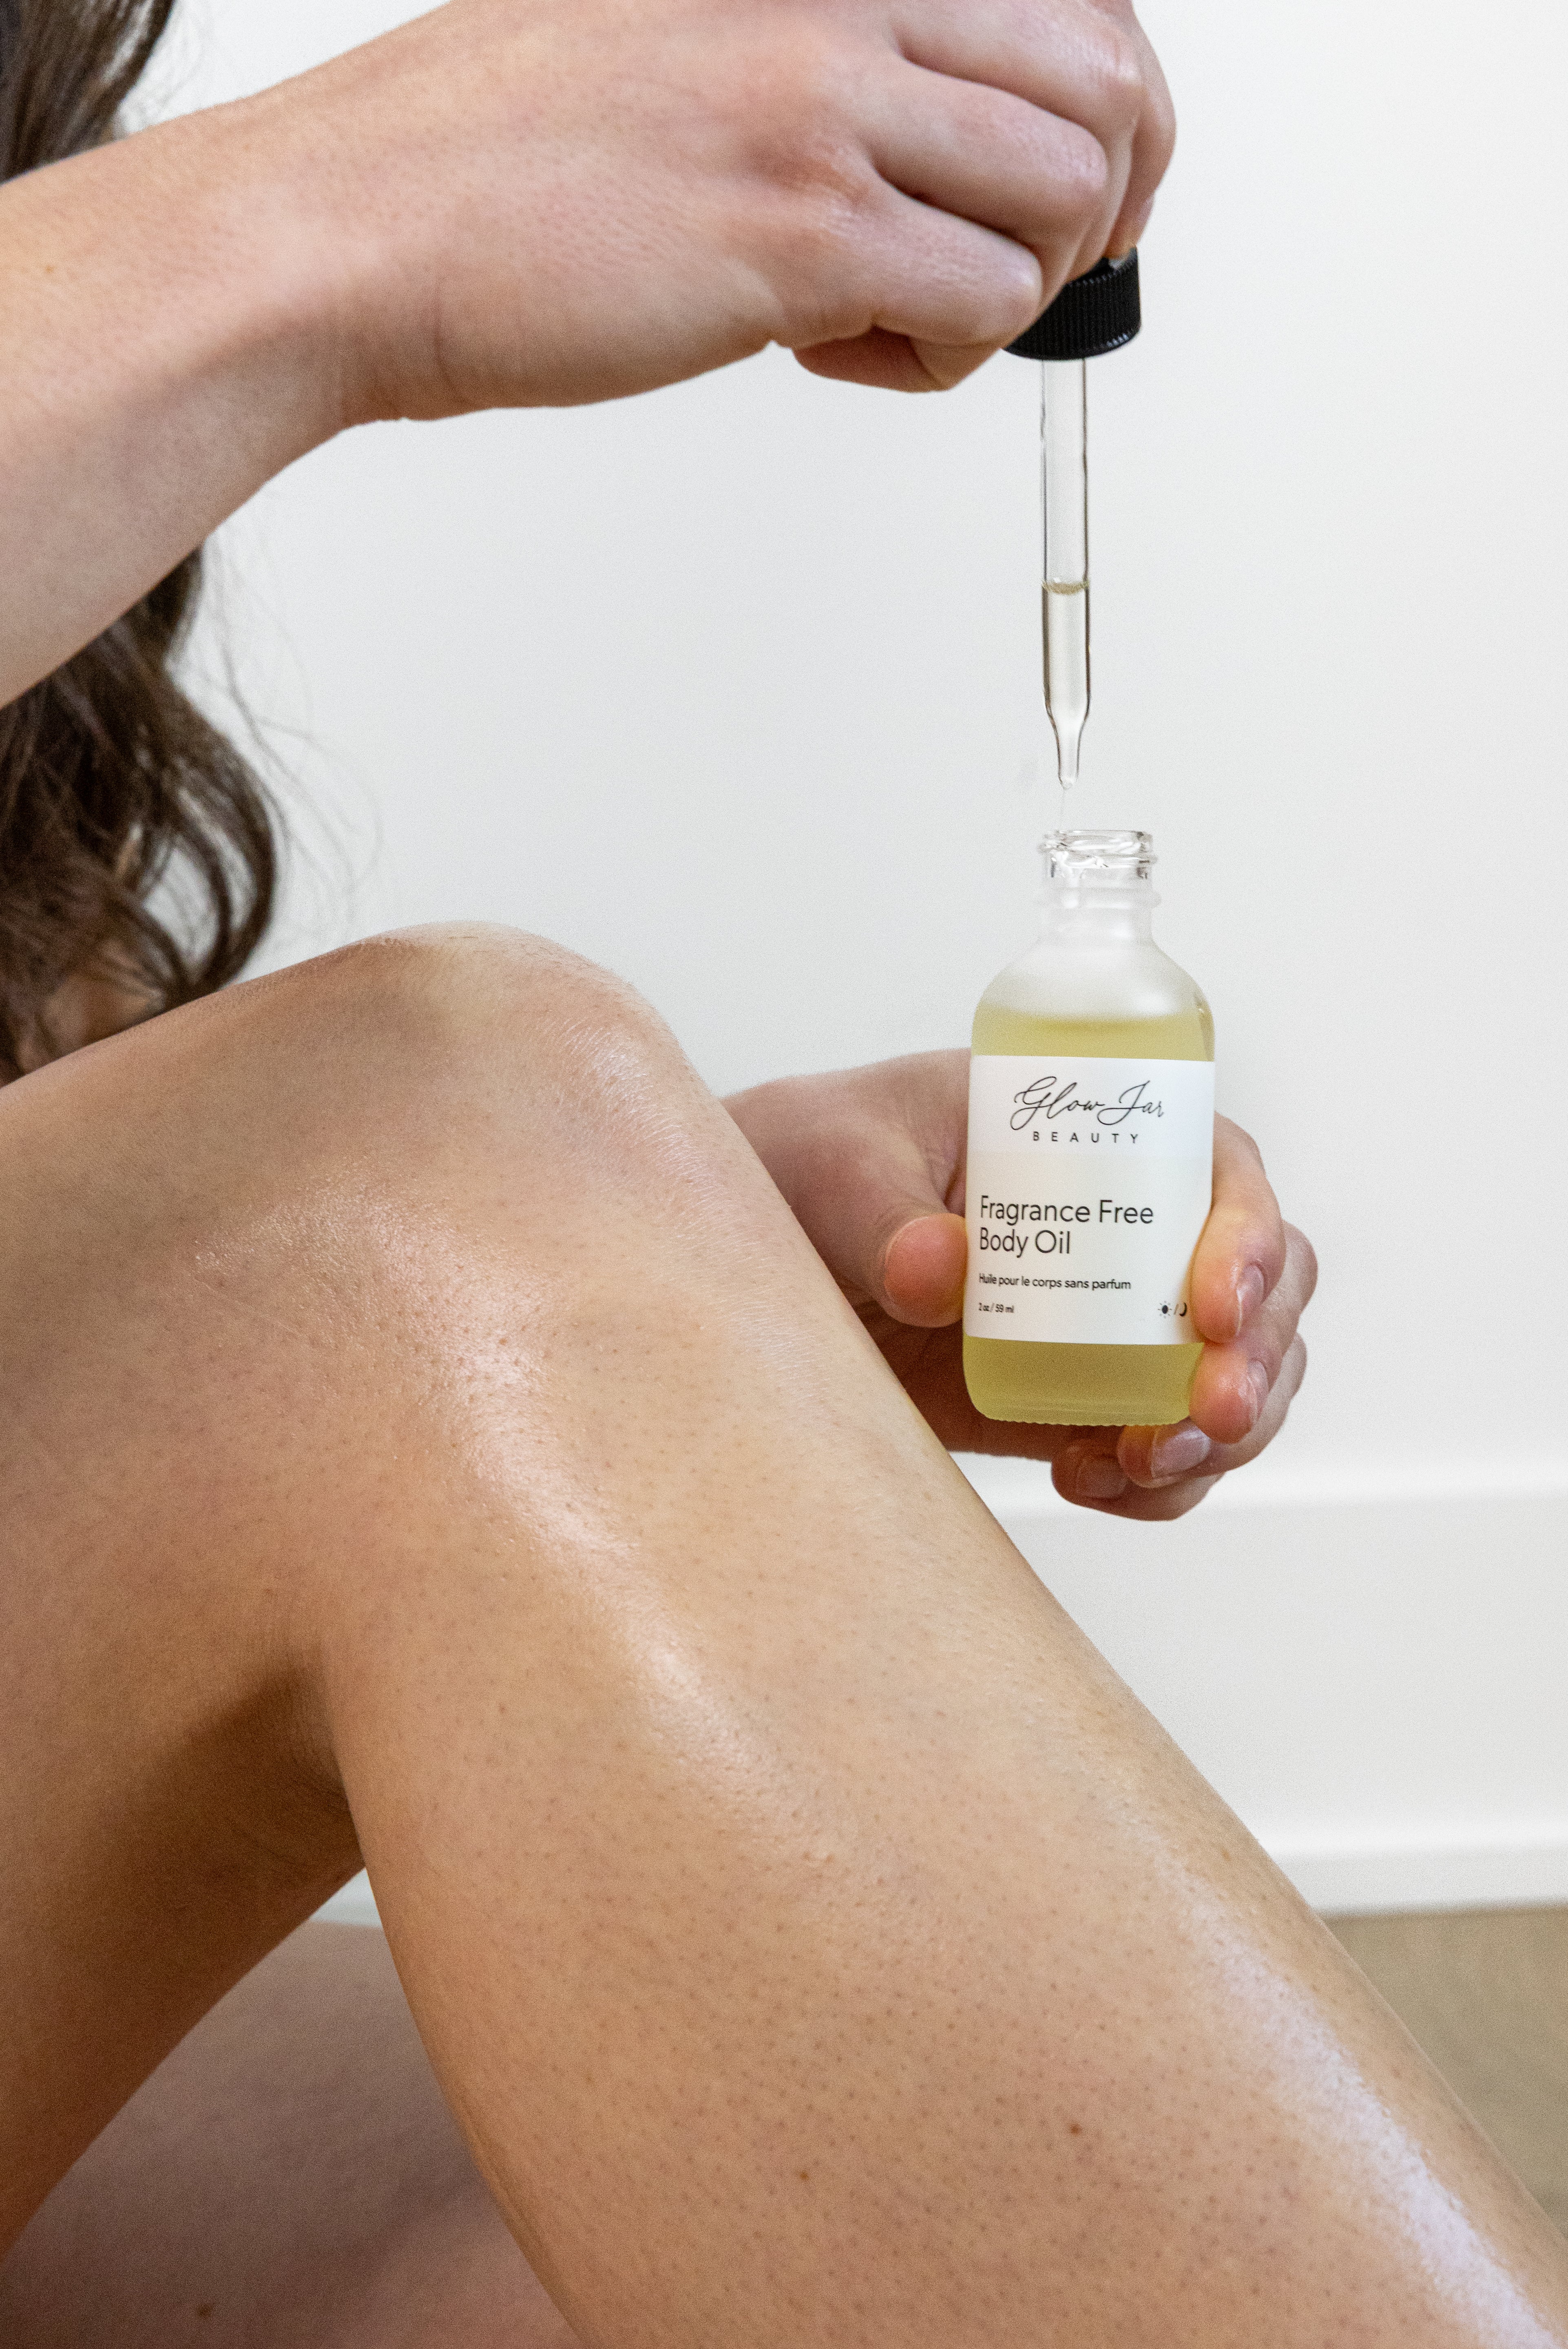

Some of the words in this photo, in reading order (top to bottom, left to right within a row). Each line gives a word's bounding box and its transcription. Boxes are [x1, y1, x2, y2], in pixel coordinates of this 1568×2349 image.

[1010, 1076, 1104, 1130] Glow
[1097, 1080, 1164, 1126] Jar
[1033, 1131, 1139, 1144] BEAUTY
[980, 1195, 1091, 1227] Fragrance
[1099, 1199, 1154, 1224] Free
[980, 1227, 1029, 1259] Body
[1035, 1230, 1071, 1254] Oil
[979, 1273, 997, 1284] Huile
[999, 1277, 1019, 1287] pour
[1021, 1276, 1030, 1286] le
[1032, 1279, 1062, 1289] corps
[1064, 1280, 1089, 1288] sans
[1092, 1279, 1131, 1291] parfum
